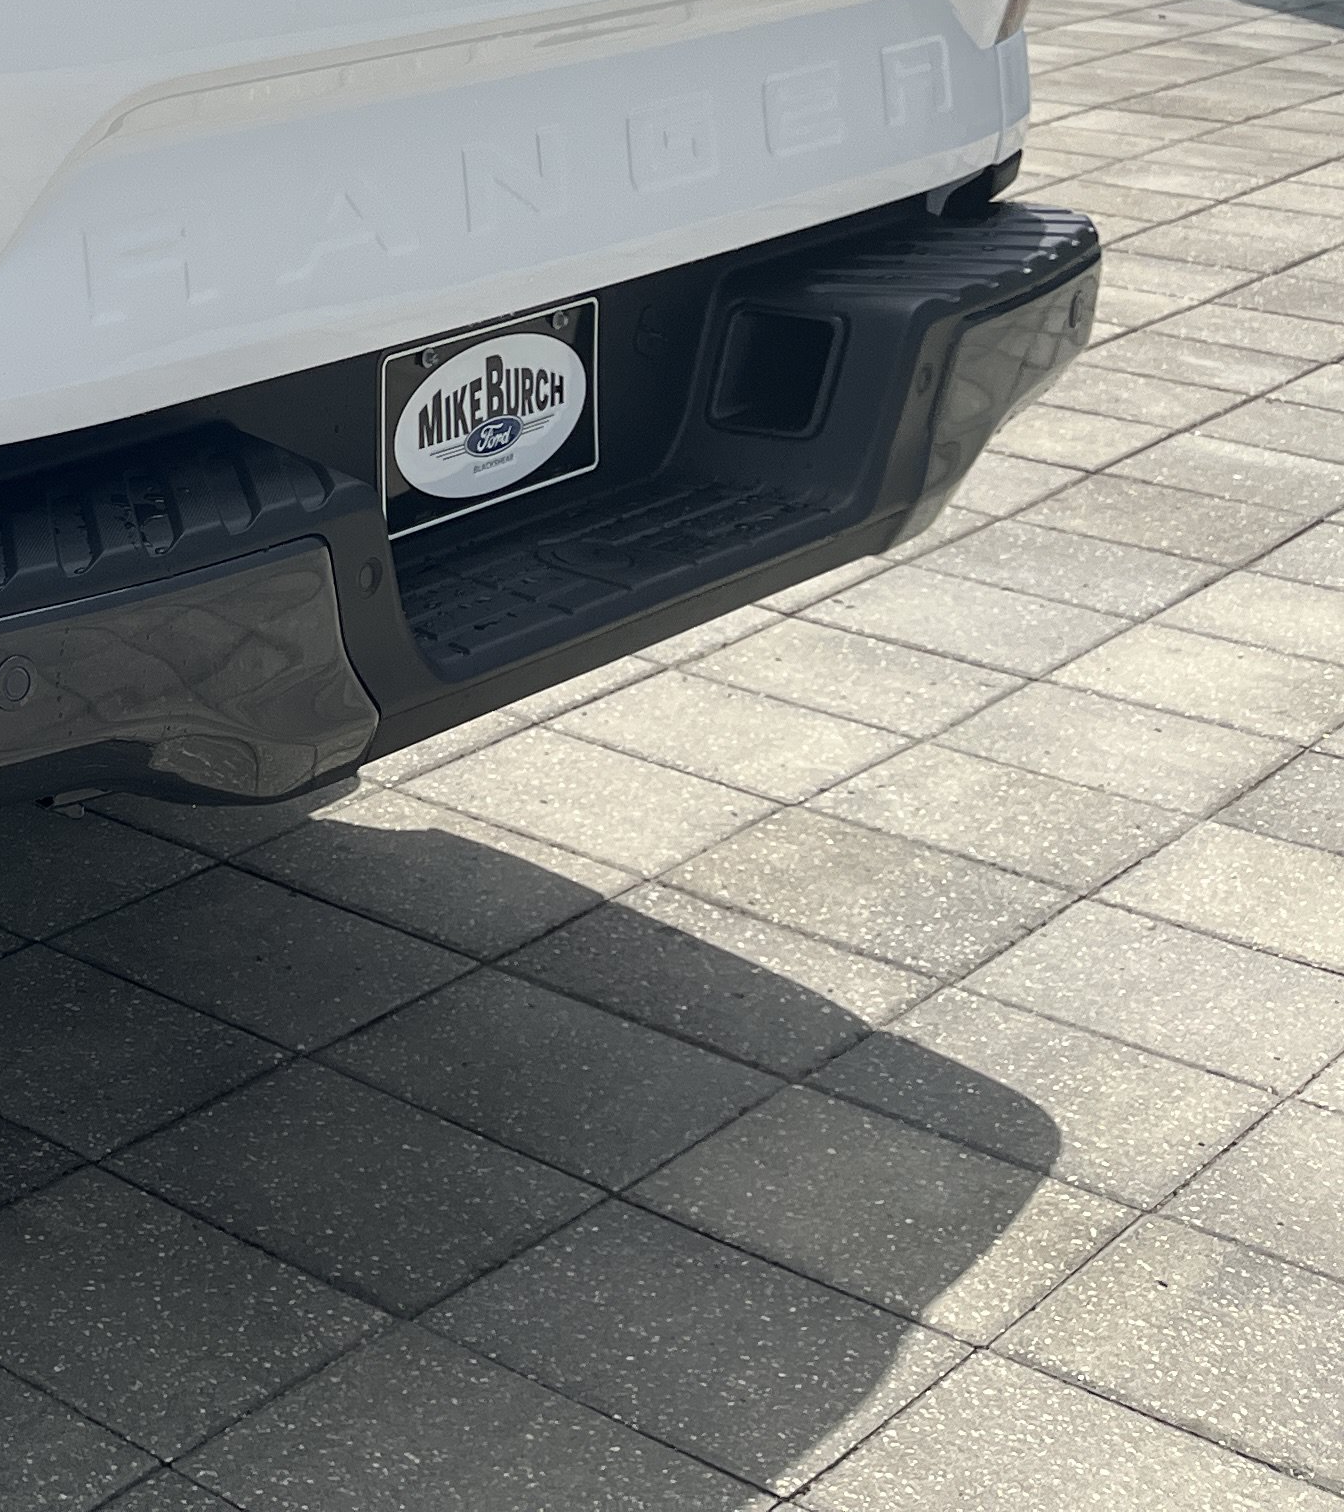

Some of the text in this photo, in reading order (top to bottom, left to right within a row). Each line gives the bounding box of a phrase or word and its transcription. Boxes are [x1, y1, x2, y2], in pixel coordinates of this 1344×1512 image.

[79, 33, 953, 328] RANGER
[476, 422, 513, 453] Ford
[473, 453, 514, 474] BLACKSHEAR
